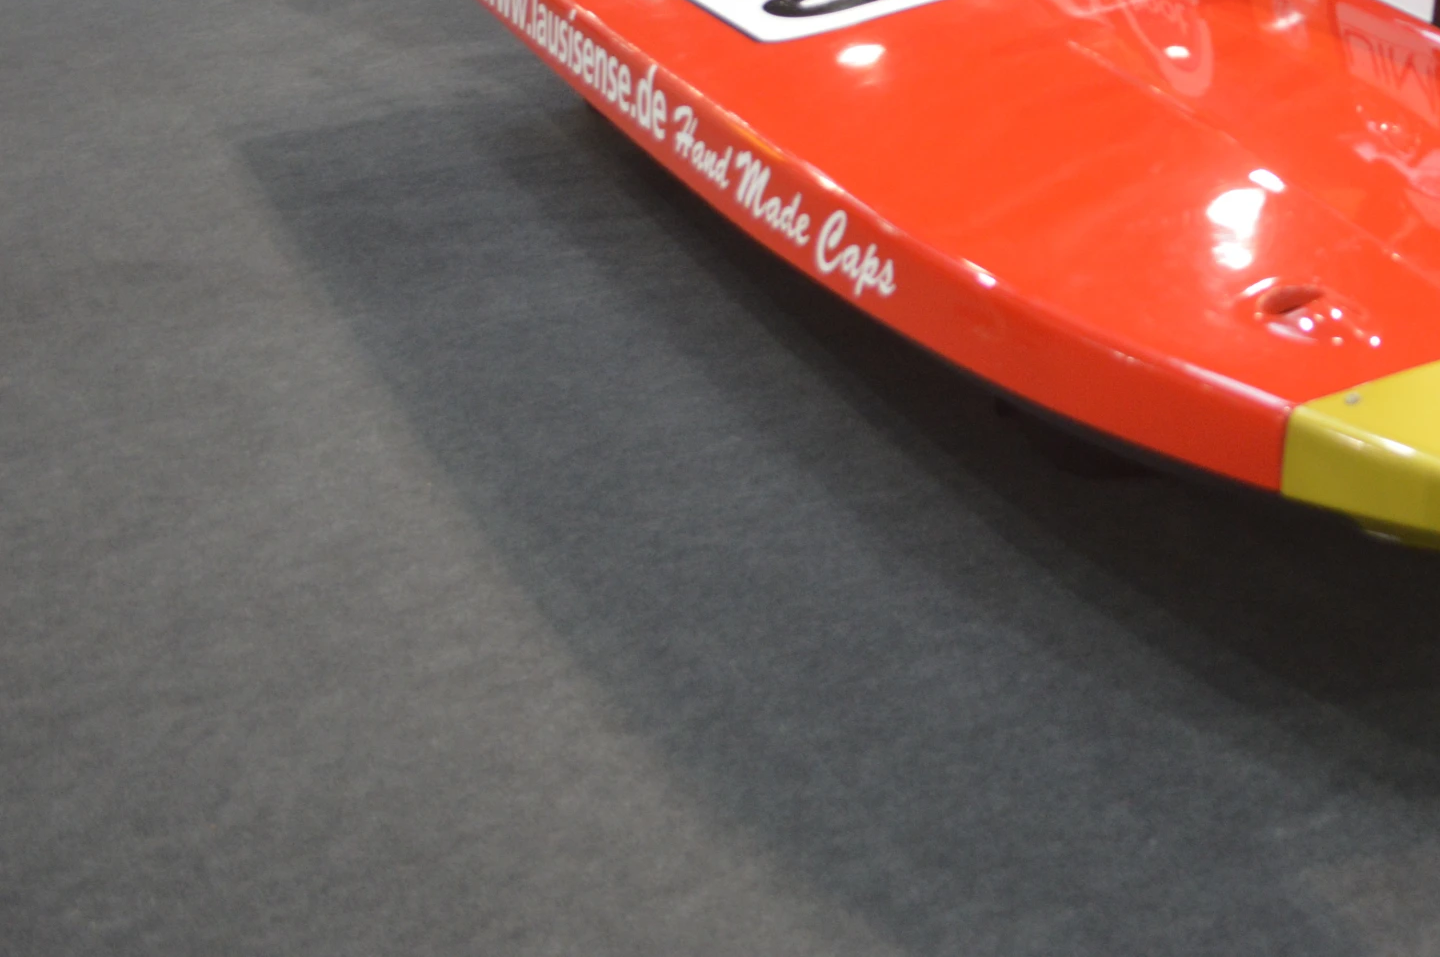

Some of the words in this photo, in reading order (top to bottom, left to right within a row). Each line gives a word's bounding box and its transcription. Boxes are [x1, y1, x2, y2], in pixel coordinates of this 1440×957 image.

[673, 104, 733, 191] Hand
[735, 150, 812, 247] Made
[815, 209, 898, 298] Caps
